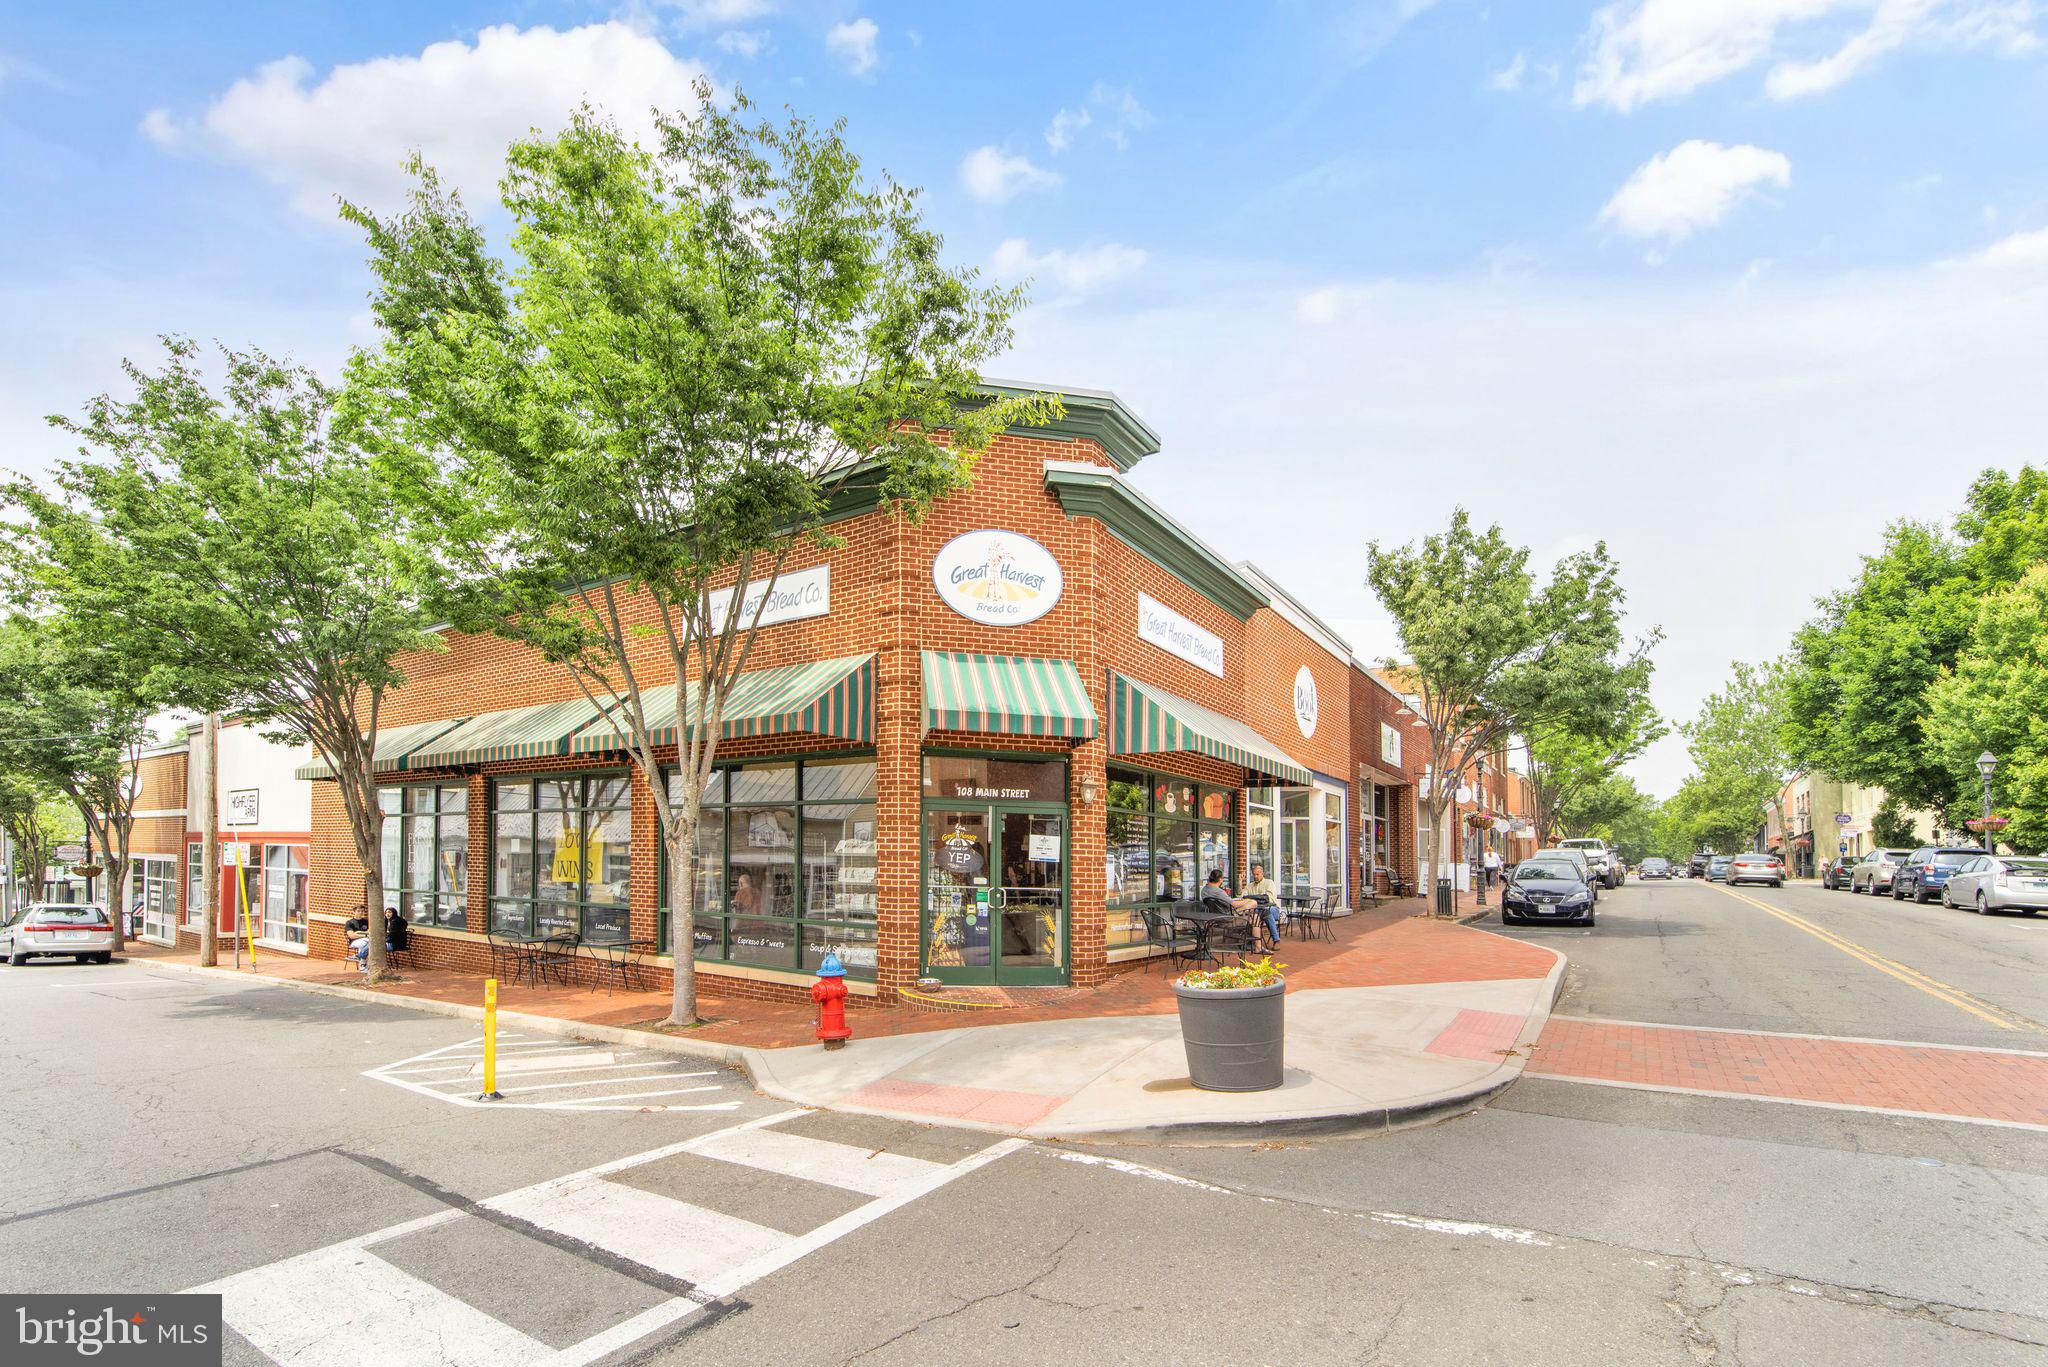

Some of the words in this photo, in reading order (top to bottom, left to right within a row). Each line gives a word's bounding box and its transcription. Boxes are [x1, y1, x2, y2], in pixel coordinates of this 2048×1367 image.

[951, 563, 990, 584] Great
[1000, 564, 1045, 591] Harvest
[767, 584, 803, 613] Bread
[805, 582, 822, 603] Co.
[976, 602, 1004, 614] Bread
[1147, 612, 1168, 638] Great
[1168, 621, 1193, 654] Harvest
[1193, 638, 1212, 662] Bread
[956, 787, 973, 797] 108
[975, 787, 998, 798] MAIN
[1000, 788, 1030, 799] STREET
[948, 851, 971, 864] YEP
[557, 860, 593, 880] WINS
[595, 922, 606, 930] Local
[606, 923, 621, 931] Produce
[694, 932, 713, 941] Muffins
[737, 936, 759, 946] Espresso
[759, 938, 765, 946] &
[810, 943, 825, 955] Soup
[825, 944, 831, 953] &
